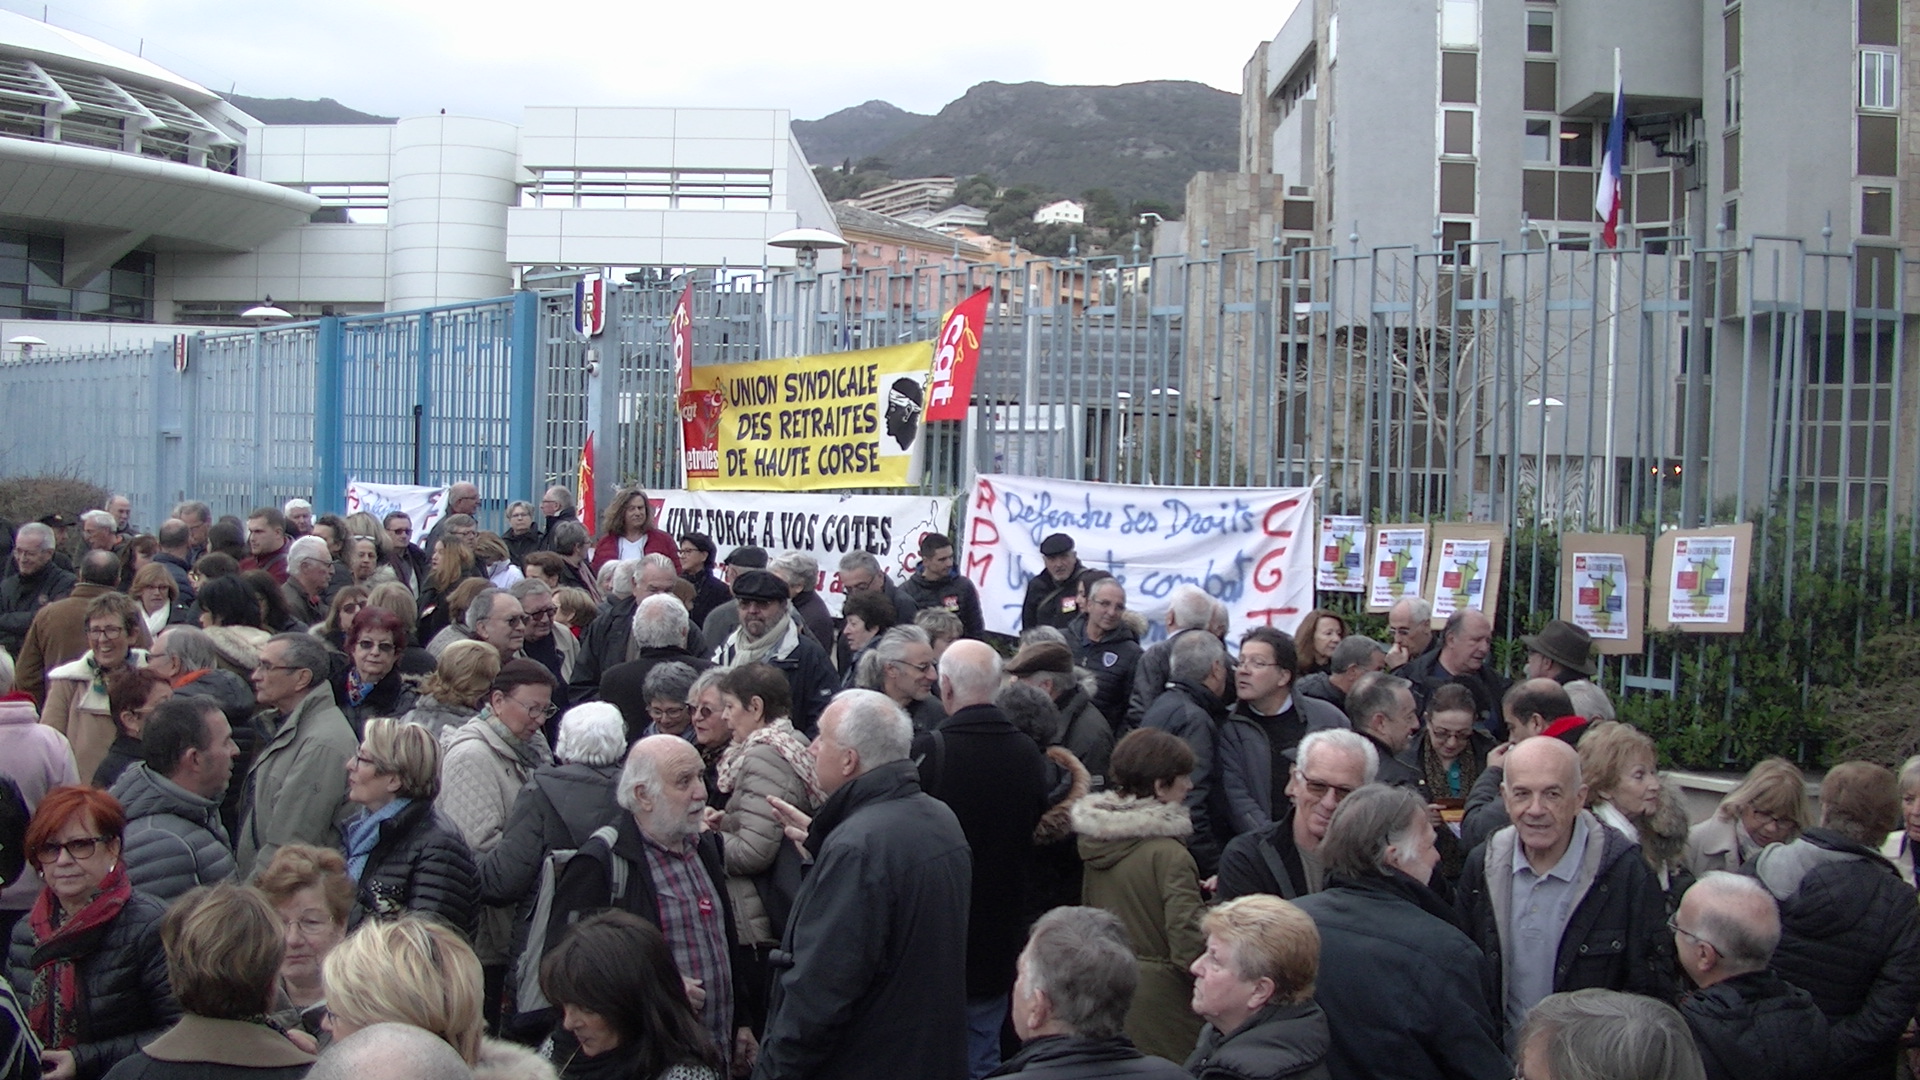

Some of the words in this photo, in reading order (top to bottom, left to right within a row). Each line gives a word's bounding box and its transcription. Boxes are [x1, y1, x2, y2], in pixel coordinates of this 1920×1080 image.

[730, 374, 778, 407] UNION
[785, 364, 878, 403] SYNDICALE
[737, 411, 772, 441] DES
[779, 402, 877, 439] RETRAITES
[726, 450, 748, 478] DE
[754, 447, 810, 478] HAUTE
[818, 442, 880, 476] CORSE
[666, 507, 703, 542] UNE
[706, 508, 760, 546] FORCE
[762, 511, 775, 549] A
[780, 511, 819, 552] VOS
[822, 514, 893, 556] COTES
[1162, 498, 1254, 540] Droits
[1140, 549, 1254, 603] combat
